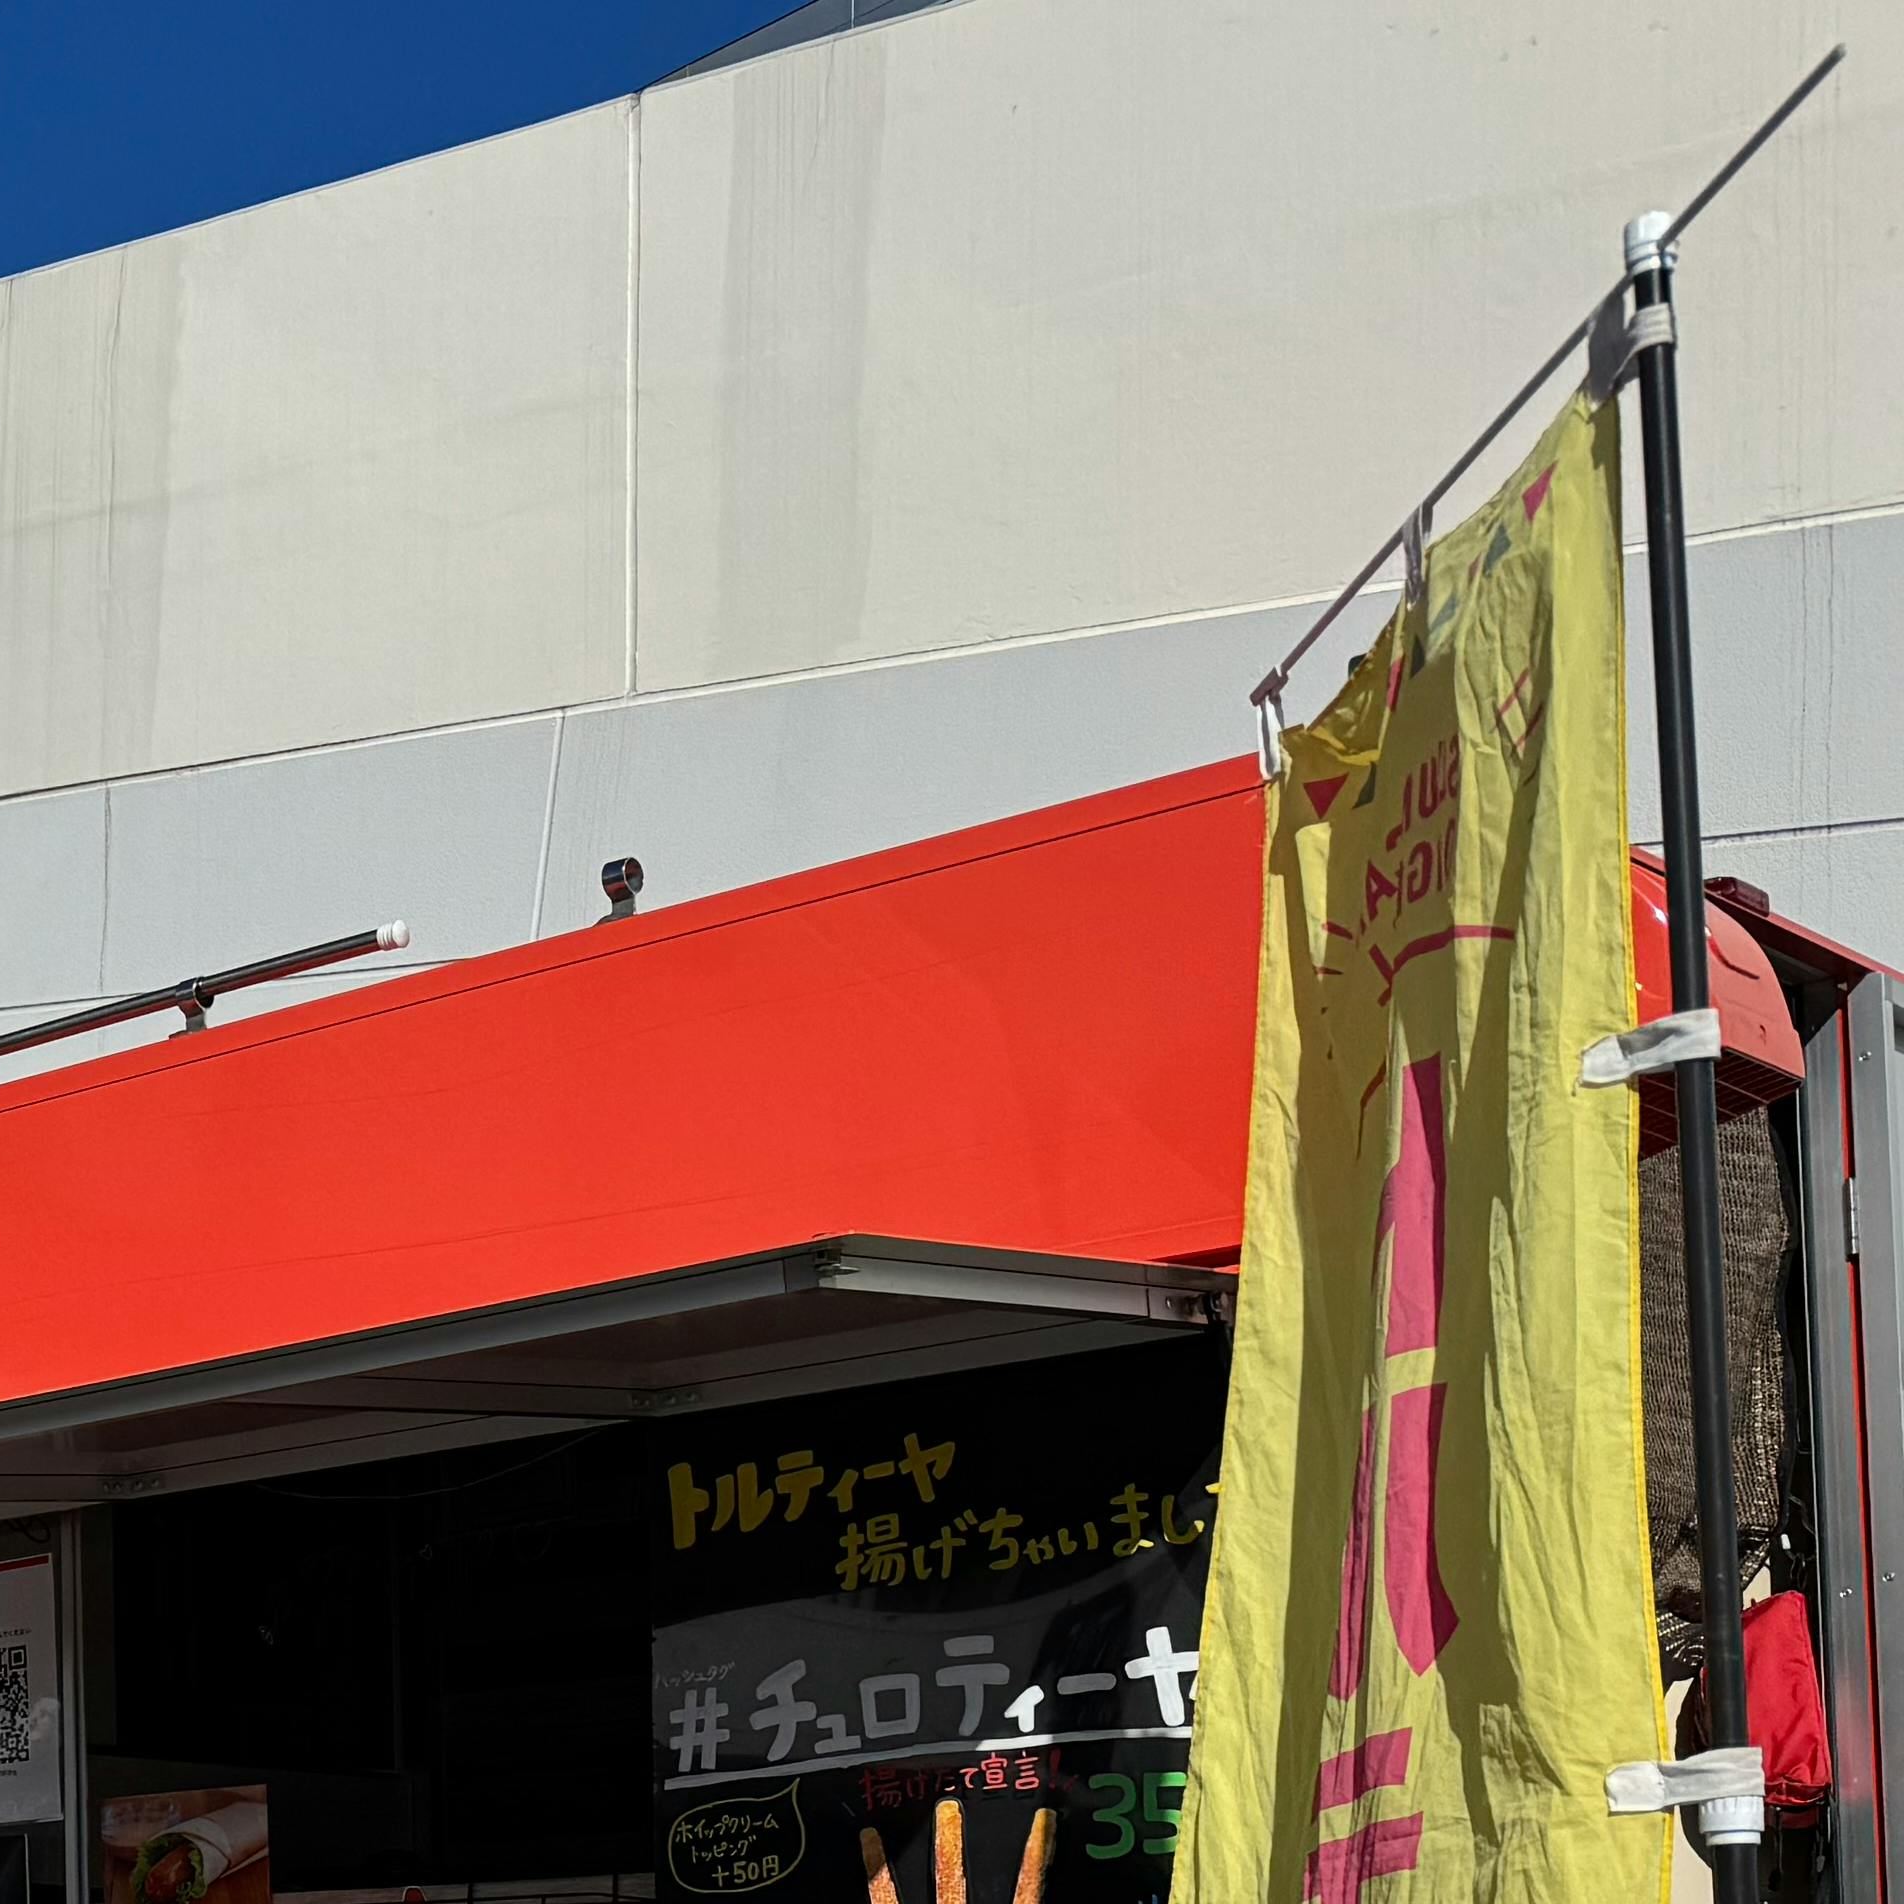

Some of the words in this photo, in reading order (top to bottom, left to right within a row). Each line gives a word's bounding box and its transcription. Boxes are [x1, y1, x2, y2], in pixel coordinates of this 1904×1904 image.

[667, 1432, 956, 1550] トルティーヤ
[834, 1480, 1225, 1592] 揚げちゃいまし
